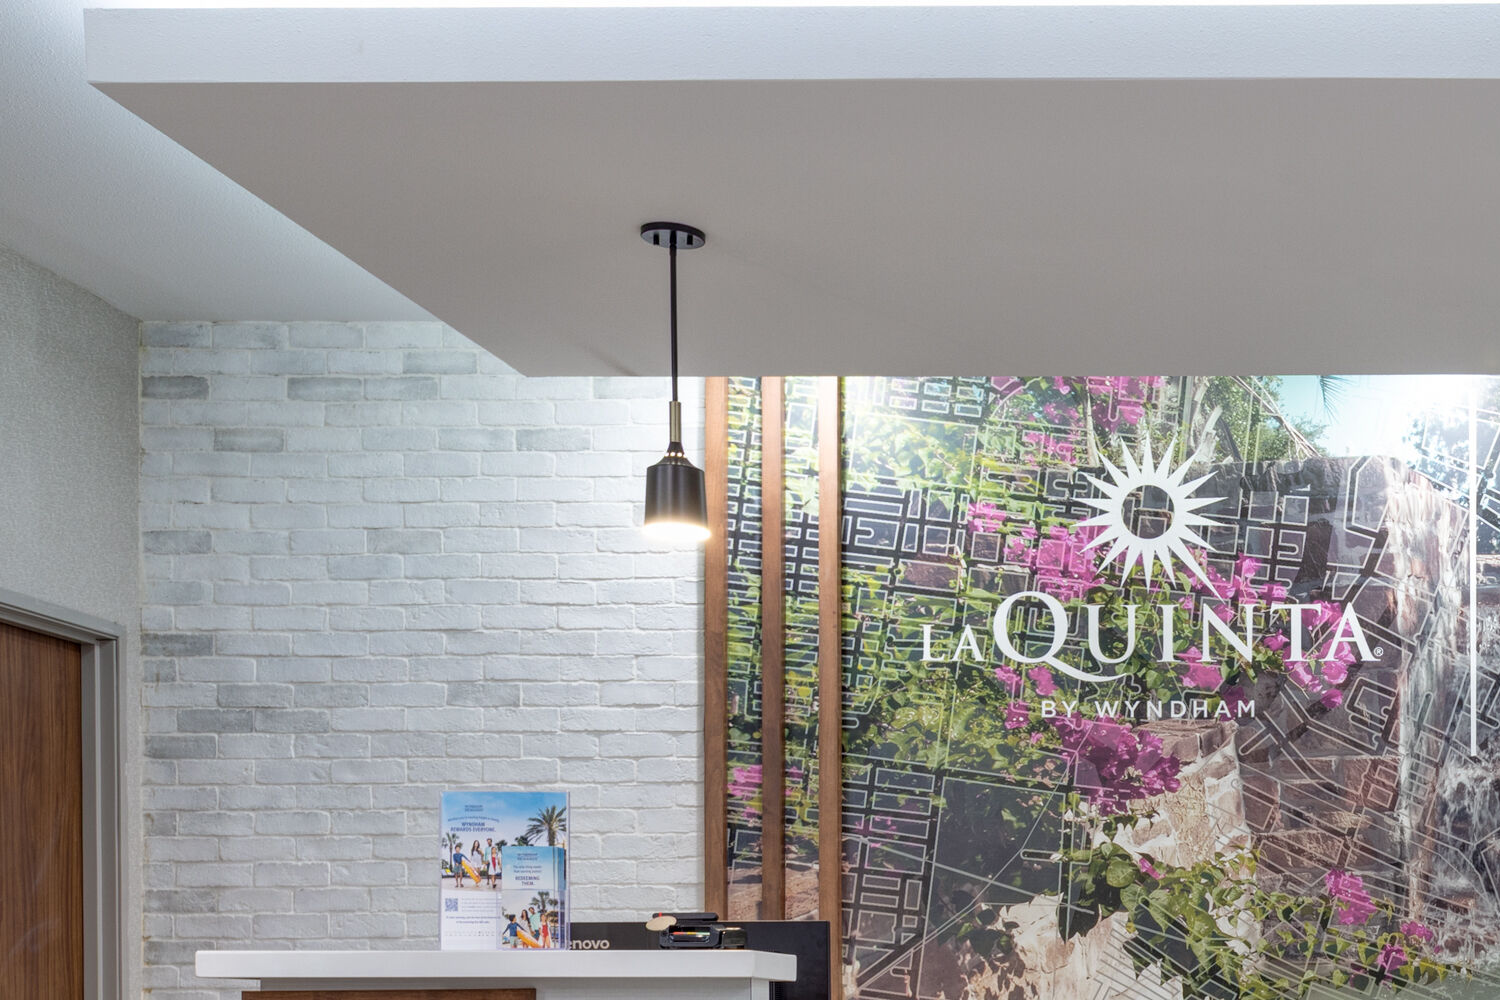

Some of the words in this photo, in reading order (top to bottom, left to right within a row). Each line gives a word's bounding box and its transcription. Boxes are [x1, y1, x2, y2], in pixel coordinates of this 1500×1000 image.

[920, 624, 984, 661] LA
[1041, 700, 1075, 718] BY
[1095, 700, 1256, 718] WYNDHAM
